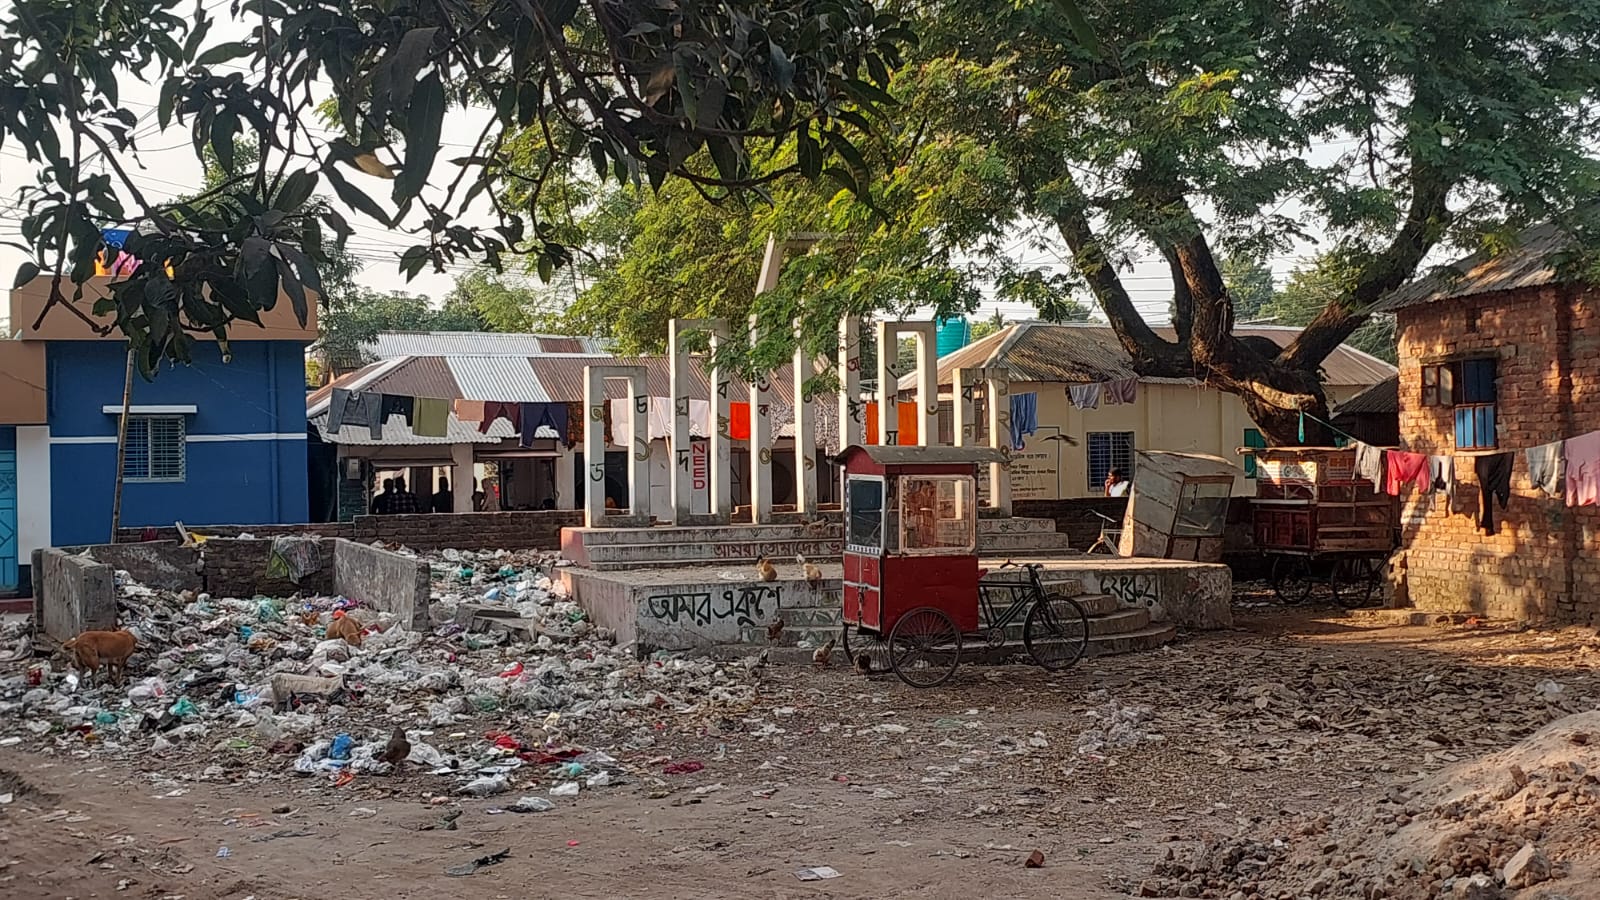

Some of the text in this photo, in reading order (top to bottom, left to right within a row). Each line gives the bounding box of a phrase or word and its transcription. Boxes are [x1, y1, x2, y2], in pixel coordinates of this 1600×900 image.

[634, 395, 648, 413] চ
[758, 404, 770, 416] ক
[676, 449, 690, 472] দ
[692, 444, 706, 490] NEED
[649, 586, 782, 626] অমর একুশে
